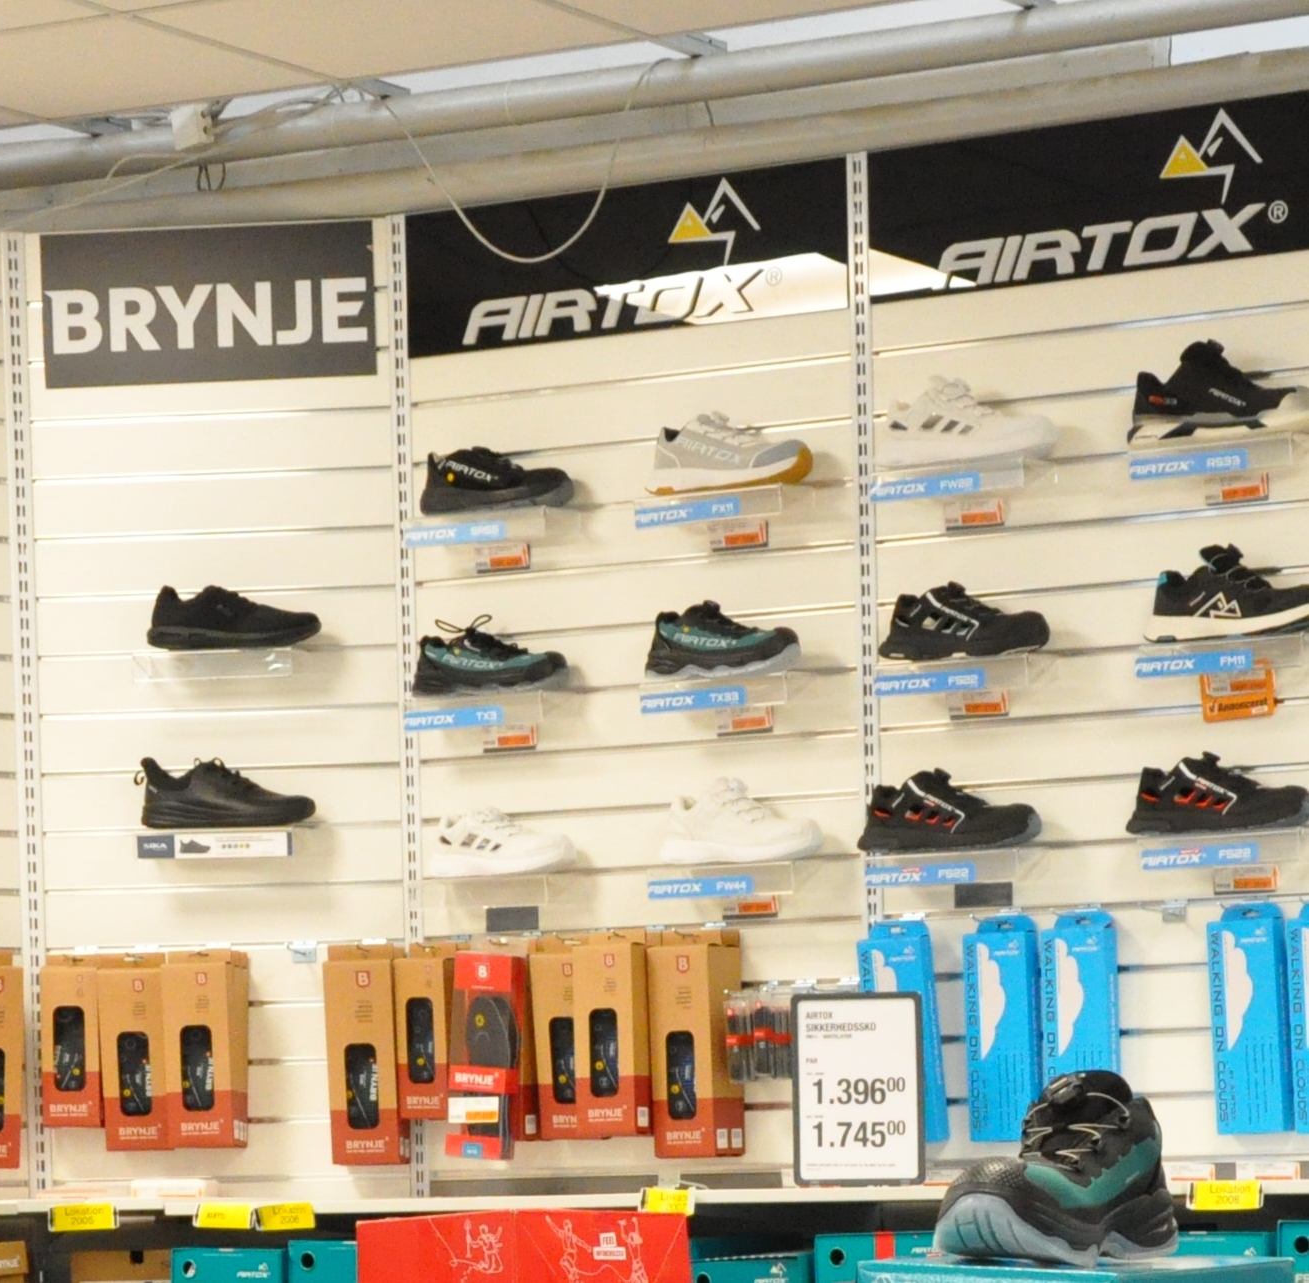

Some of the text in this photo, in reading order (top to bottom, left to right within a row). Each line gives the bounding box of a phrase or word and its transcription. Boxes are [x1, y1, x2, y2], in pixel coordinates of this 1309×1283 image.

[44, 277, 368, 354] BRYNJE
[445, 459, 492, 482] AIRTOX
[712, 502, 734, 514] FX11
[674, 633, 729, 648] AIRTOX
[1219, 655, 1246, 667] FM11
[710, 691, 739, 702] TX33
[476, 711, 497, 721] TX3
[716, 881, 746, 892] FW44
[1043, 939, 1055, 1022] WALKING
[806, 1022, 876, 1031] SIKKERHEDSSKO
[1210, 931, 1229, 1123] WALKING ON CLOUDS
[1289, 928, 1308, 1122] WALKING ON CLOUDS
[965, 944, 981, 1132] WALKING ON CLOUDS
[1046, 1032, 1056, 1057] ON
[455, 1072, 494, 1086] BRYNJE
[406, 1096, 440, 1105] BRYNJE
[49, 1104, 88, 1113] BRYNJE
[588, 1107, 623, 1118] BRYNJE
[552, 1114, 577, 1124] BRYN
[119, 1127, 158, 1136] BRYNJE
[181, 1122, 220, 1132] BRYNJE
[666, 1130, 701, 1140] BRYNJE
[346, 1140, 385, 1150] BRYNJE
[1209, 1185, 1251, 1194] Lokation
[64, 1206, 104, 1216] Lokation
[70, 1216, 94, 1225] 2005
